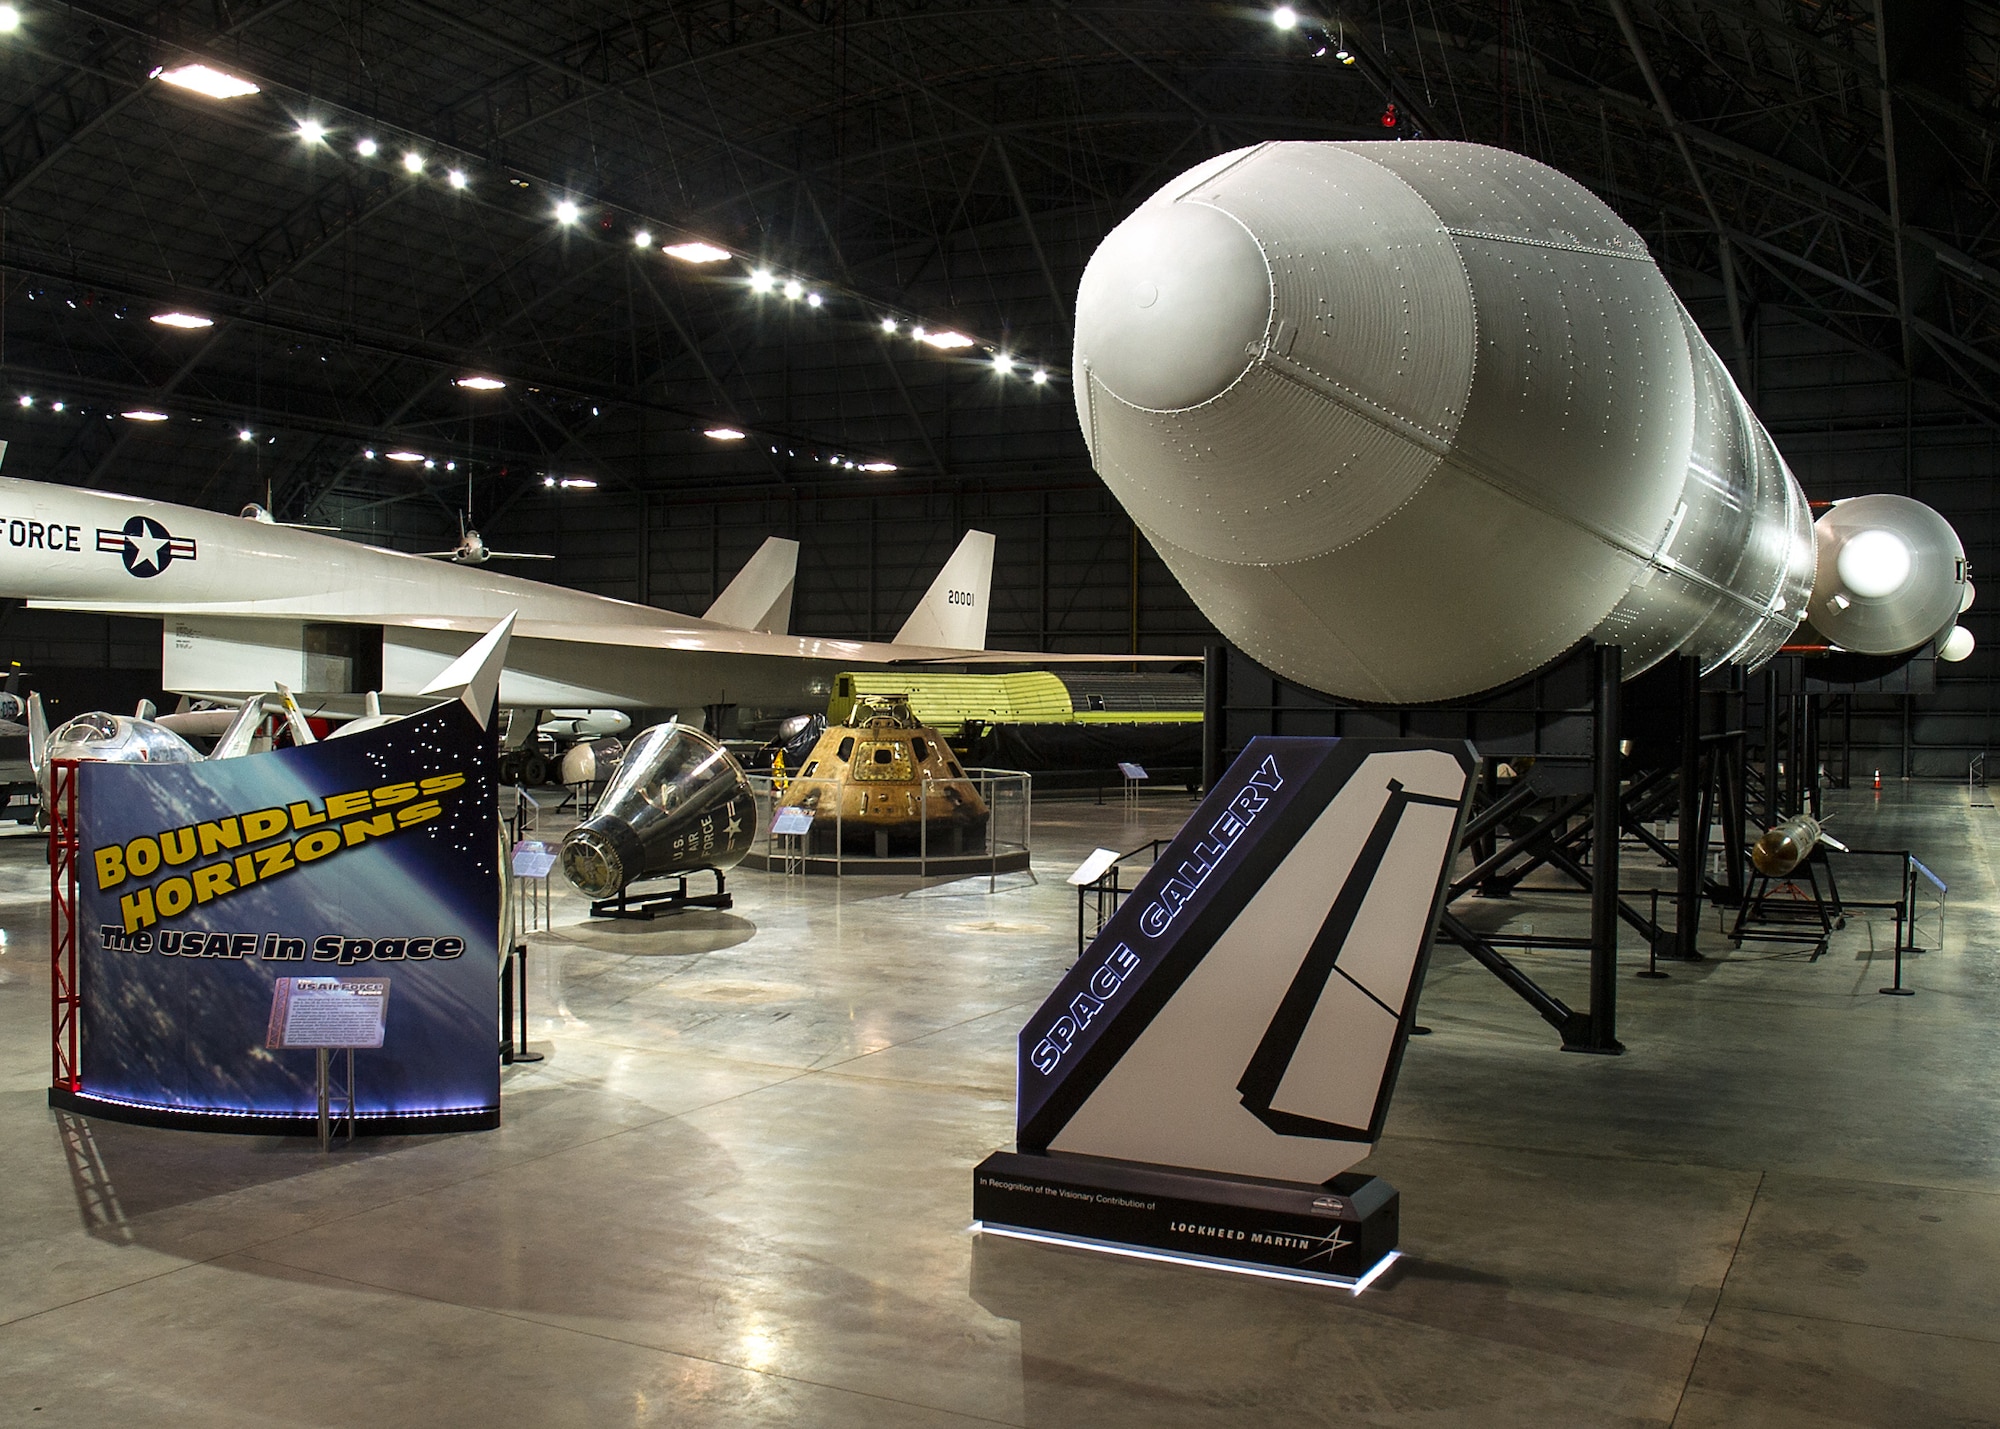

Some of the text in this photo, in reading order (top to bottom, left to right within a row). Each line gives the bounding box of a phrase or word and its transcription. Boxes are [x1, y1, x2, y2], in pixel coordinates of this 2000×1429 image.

[948, 589, 975, 607] 20001
[94, 772, 466, 890] BOUNDLESS
[688, 831, 700, 852] AIR
[701, 814, 715, 858] FORCE
[673, 835, 684, 861] U.S.
[120, 799, 443, 934] HORIZONS
[1031, 754, 1284, 1075] SPACE GALLERY
[100, 924, 465, 965] The USAF in Space
[341, 983, 384, 991] Force
[980, 1177, 1156, 1210] In Recognition of the Visionary Contribution of
[1170, 1221, 1309, 1250] LOCKHEED MARTIN
